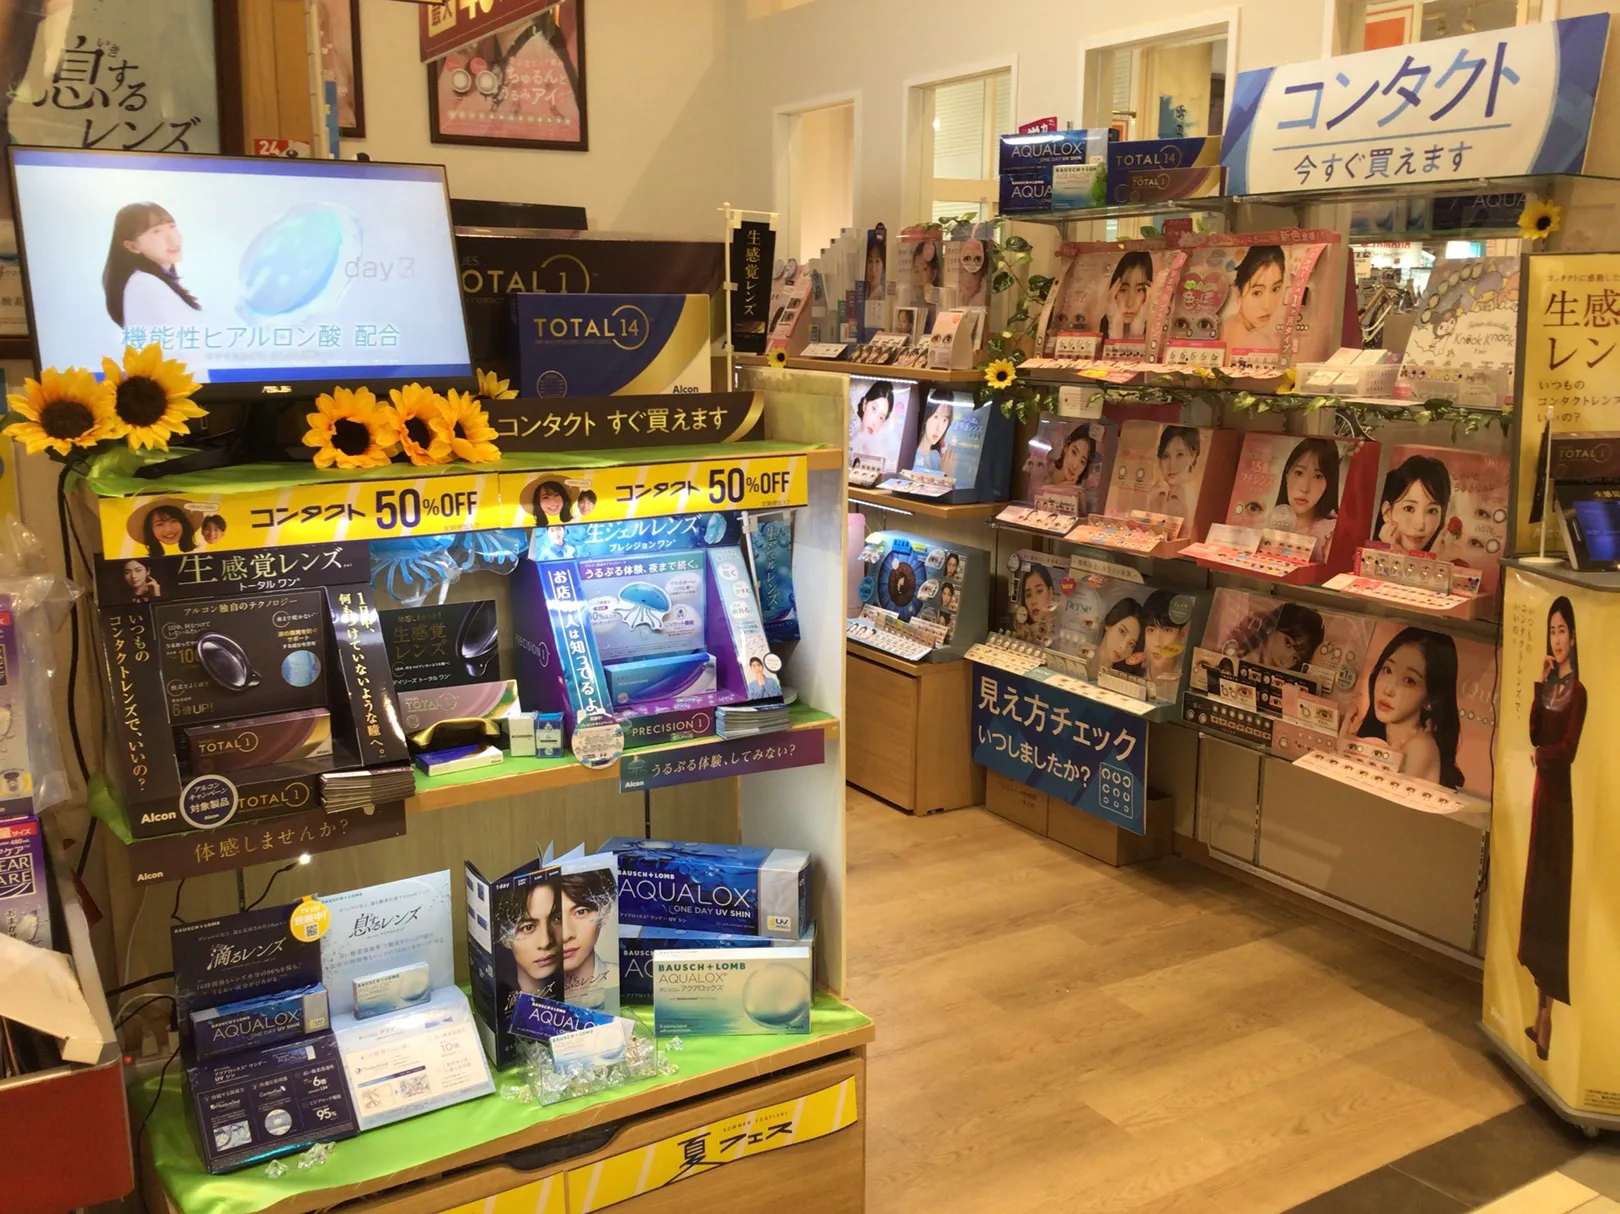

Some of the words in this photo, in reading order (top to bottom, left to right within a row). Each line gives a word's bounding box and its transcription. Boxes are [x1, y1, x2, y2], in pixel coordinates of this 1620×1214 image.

[32, 35, 147, 112] 息する
[1277, 41, 1520, 131] コンタクト
[82, 116, 201, 152] レンズ
[1011, 142, 1083, 158] AQUALOX
[1116, 154, 1160, 166] TOTAL
[1163, 153, 1175, 164] 14
[1294, 141, 1473, 185] 今すぐ買えます
[1011, 185, 1052, 198] AQUA
[1132, 178, 1159, 186] TOTAL
[1472, 192, 1526, 209] AQUA
[345, 256, 394, 282] day
[744, 229, 761, 316] 生感覚レンズ
[462, 270, 546, 293] OTAL
[121, 325, 341, 350] 機能性ヒアルロン酸
[354, 324, 401, 348] 配合
[533, 317, 615, 338] TOTAL
[620, 317, 639, 336] 14
[1548, 336, 1617, 371] レン
[261, 385, 292, 394] ASUS
[672, 384, 699, 394] Alcon
[1539, 380, 1585, 391] いつもの
[497, 411, 596, 438] コンタクト
[607, 405, 728, 434] すぐ買えます
[1559, 449, 1596, 458] TOTAL
[616, 480, 700, 502] コンタクト
[251, 502, 366, 529] コンタクト
[587, 512, 702, 544] 生ジェルレンズ
[609, 541, 657, 553] プレシジョン
[658, 538, 675, 548] ワン
[178, 547, 344, 586] 生感覚レンズ
[585, 559, 699, 579] うるぷる体験、夜まで続く。
[239, 580, 275, 592] トータル
[277, 577, 298, 589] ワン
[184, 598, 298, 616] アルコン独自のテクノロジー
[128, 613, 150, 663] いつもの
[394, 622, 447, 644] 生感覚
[552, 569, 599, 713] お店人は知ってるよ
[396, 639, 448, 660] レンズ
[632, 720, 693, 737] PRECISION
[978, 675, 1137, 762] 見え方チェック
[198, 740, 242, 753] TOTAL
[978, 724, 1091, 787] いつしましたか?
[651, 743, 797, 778] うるぷる体験、してみない?
[188, 787, 227, 801] キャンペーン
[194, 782, 221, 793] アルコン
[624, 780, 645, 788] Alcon
[189, 797, 230, 814] 対象製品
[238, 791, 289, 809] TOTAL
[141, 810, 177, 825] Alcon
[193, 818, 349, 863] 体感しませんか?
[0, 856, 30, 872] EAR
[0, 871, 32, 887] ARE
[137, 870, 164, 882] Alcon
[617, 869, 675, 880] BAUSCH+LOMB
[618, 878, 751, 908] AQUALOX
[674, 904, 692, 914] ONE
[694, 906, 713, 916] DAY
[715, 908, 729, 917] UV
[730, 909, 751, 919] SHIN
[775, 917, 788, 925] UV
[206, 936, 287, 971] 滴るレンズ
[659, 972, 724, 984] AQUALOX
[681, 984, 724, 993] アクアロックス
[213, 1009, 300, 1042] AQUALOX
[528, 1008, 597, 1031] AQUALO
[316, 1107, 337, 1121] 95%
[723, 1120, 751, 1132] SUMMER
[755, 1111, 789, 1122] FESTIVAL
[662, 1121, 793, 1188] 夏フェス
